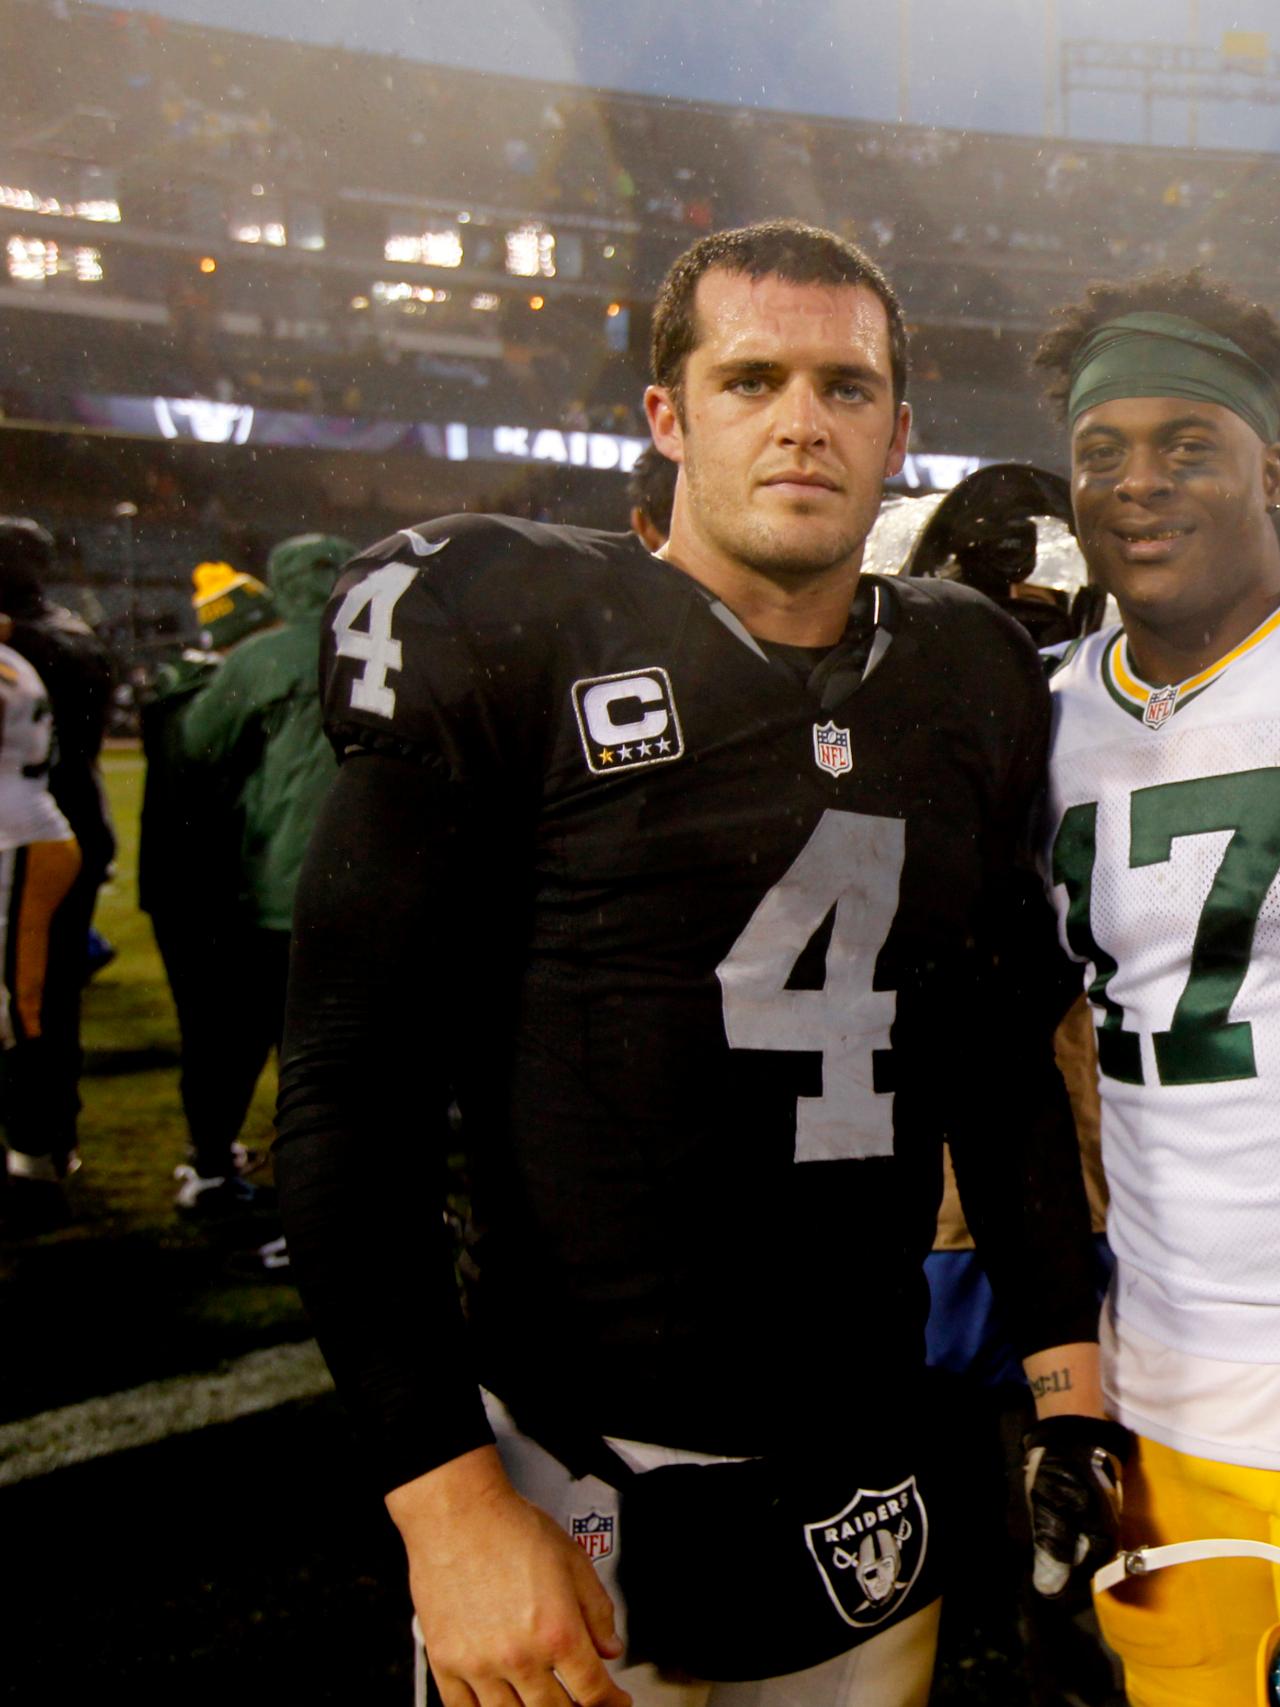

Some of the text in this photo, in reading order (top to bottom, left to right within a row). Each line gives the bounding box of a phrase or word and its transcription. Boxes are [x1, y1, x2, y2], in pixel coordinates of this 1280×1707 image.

[331, 561, 420, 720] 4
[583, 676, 669, 746] C
[1148, 701, 1169, 721] NFL
[820, 743, 847, 768] NFL
[714, 808, 906, 1163] 4
[824, 1492, 909, 1543] RAIDERS
[576, 1533, 610, 1557] NFL
